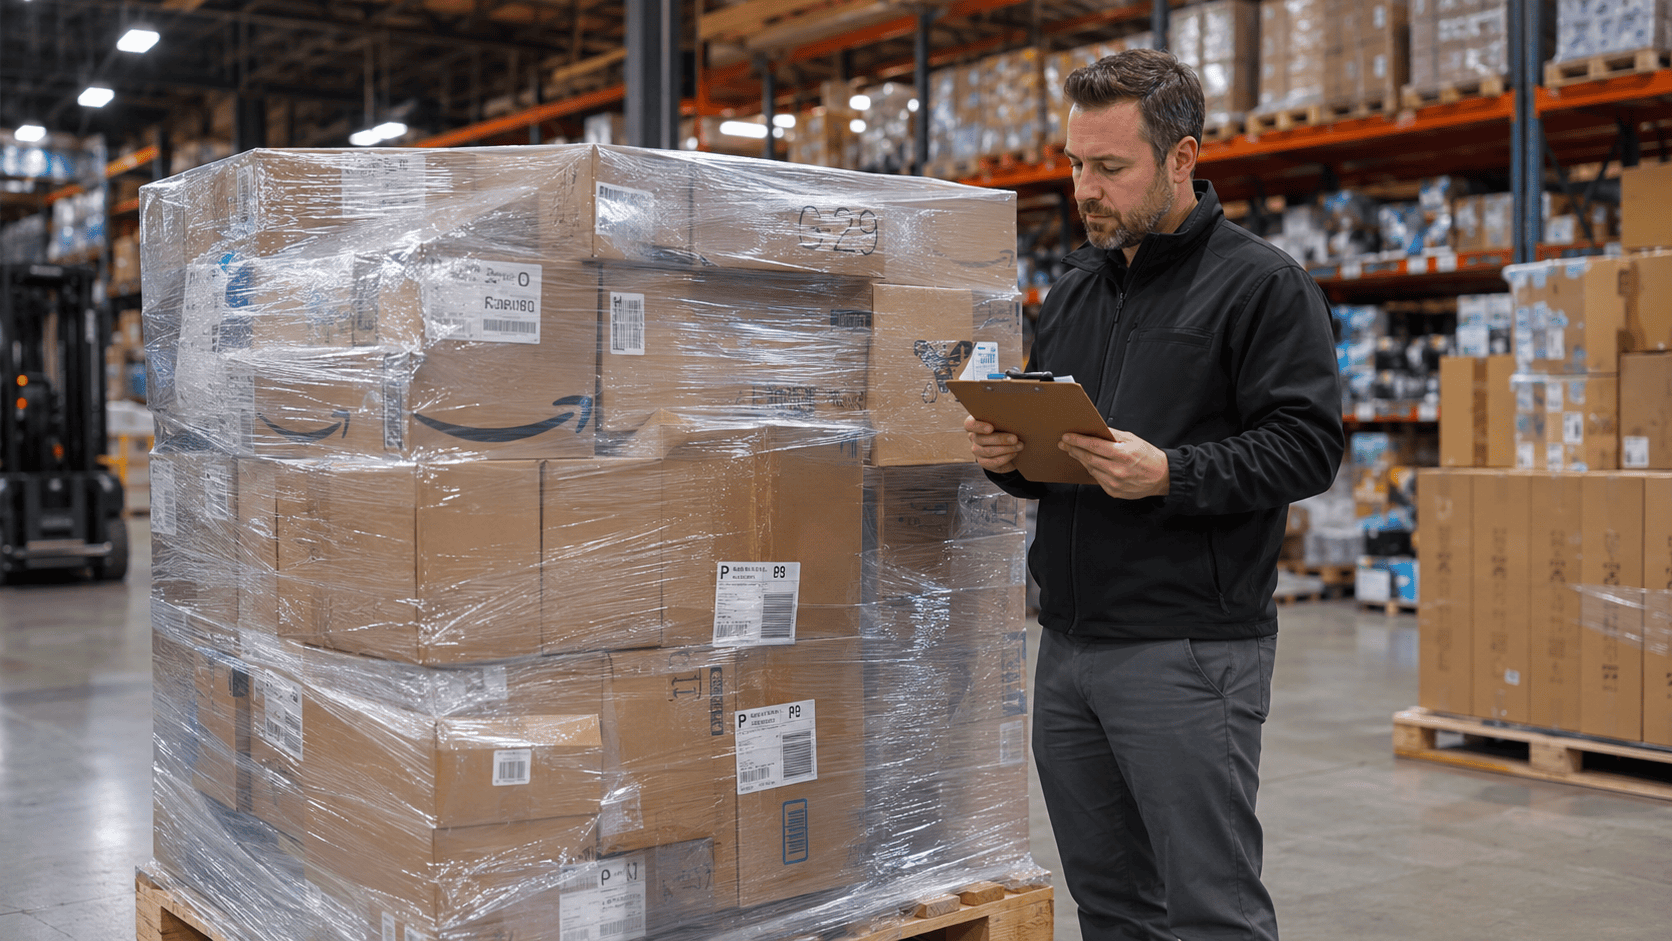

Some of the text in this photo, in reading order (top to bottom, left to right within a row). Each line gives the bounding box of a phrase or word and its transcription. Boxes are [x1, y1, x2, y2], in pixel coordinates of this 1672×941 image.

[720, 565, 730, 580] P
[738, 714, 747, 728] P
[601, 869, 611, 886] P
